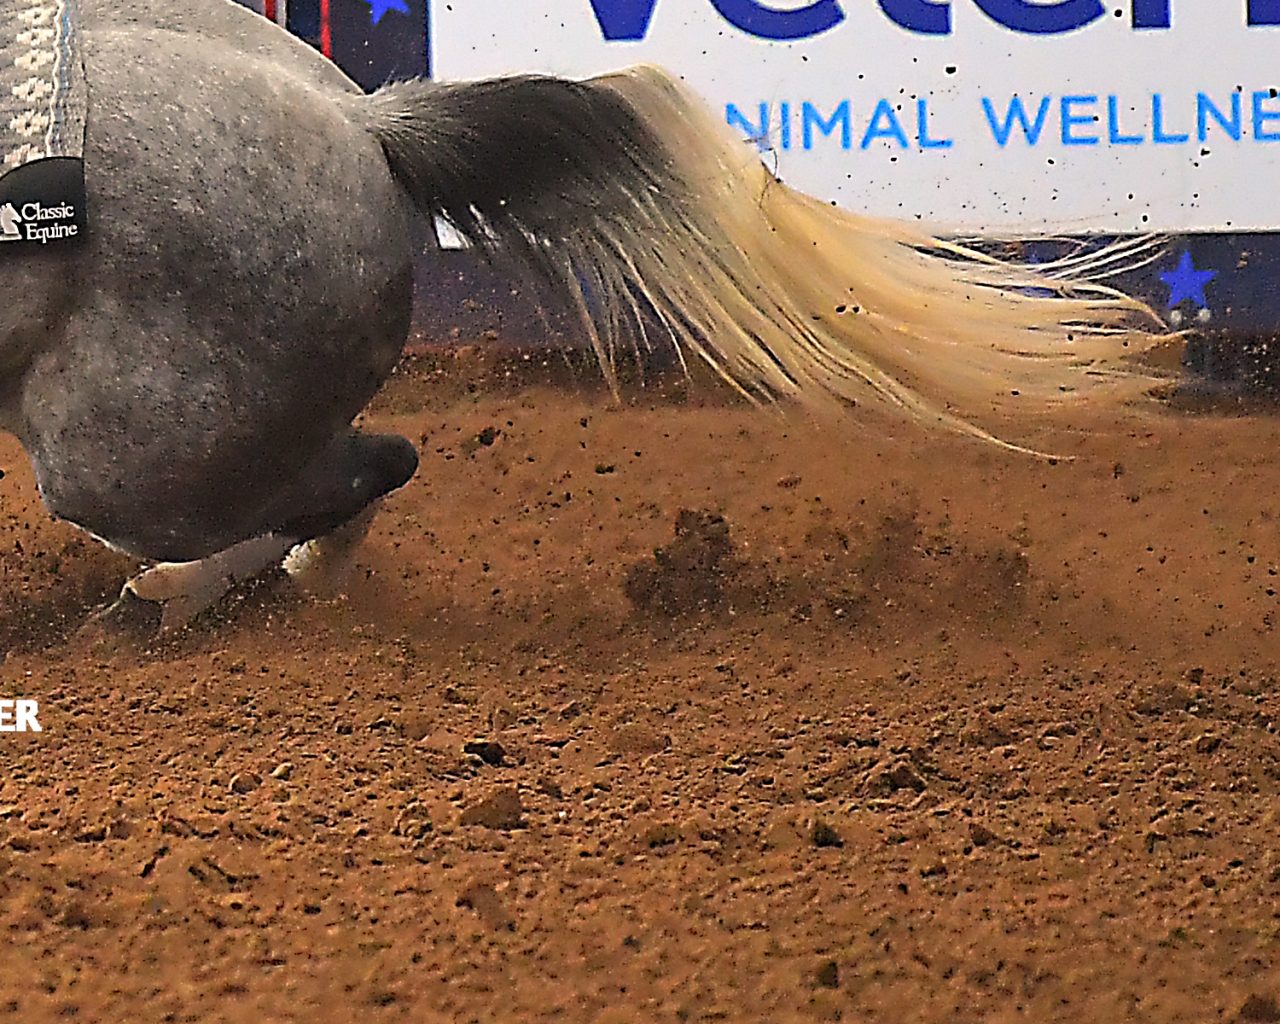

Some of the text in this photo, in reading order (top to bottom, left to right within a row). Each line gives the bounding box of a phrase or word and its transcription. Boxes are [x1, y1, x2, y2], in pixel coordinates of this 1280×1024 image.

[724, 91, 1280, 151] NIMAL WELLNE
[21, 201, 75, 221] Classic
[24, 222, 78, 244] Equine
